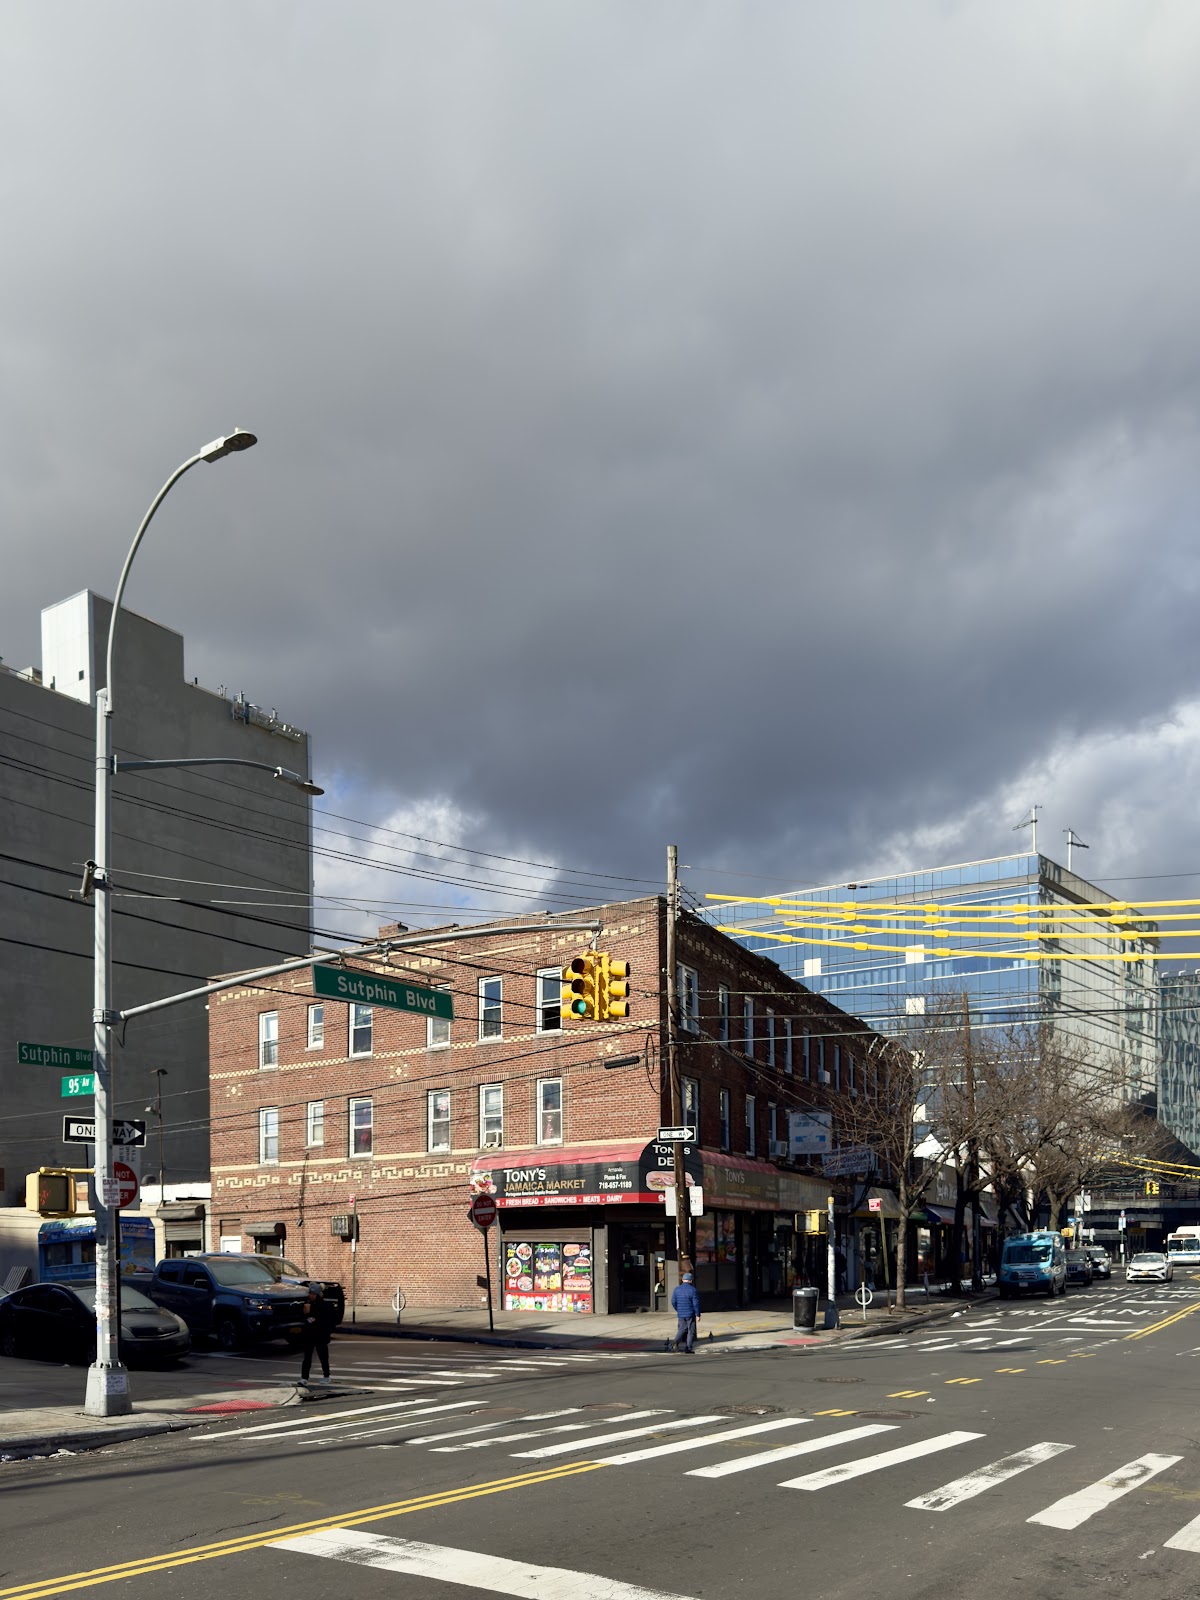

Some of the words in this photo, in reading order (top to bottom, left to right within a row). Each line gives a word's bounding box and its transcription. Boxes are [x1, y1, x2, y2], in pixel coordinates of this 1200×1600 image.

[338, 976, 397, 1002] Sutphin
[406, 991, 436, 1010] Blvd
[21, 1045, 71, 1065] Sutphin
[75, 1051, 92, 1062] Blvd
[68, 1078, 79, 1094] 95
[652, 1144, 691, 1155] TONS
[115, 1171, 130, 1179] NOT
[504, 1168, 546, 1182] TONY'S
[504, 1181, 544, 1191] JAMAICA
[546, 1179, 586, 1190] MARKET
[505, 1198, 521, 1206] FRESH
[522, 1197, 539, 1206] BREAD
[544, 1196, 577, 1205] SANDWICHES
[583, 1195, 600, 1203] MEATS
[606, 1194, 623, 1202] DAIRY
